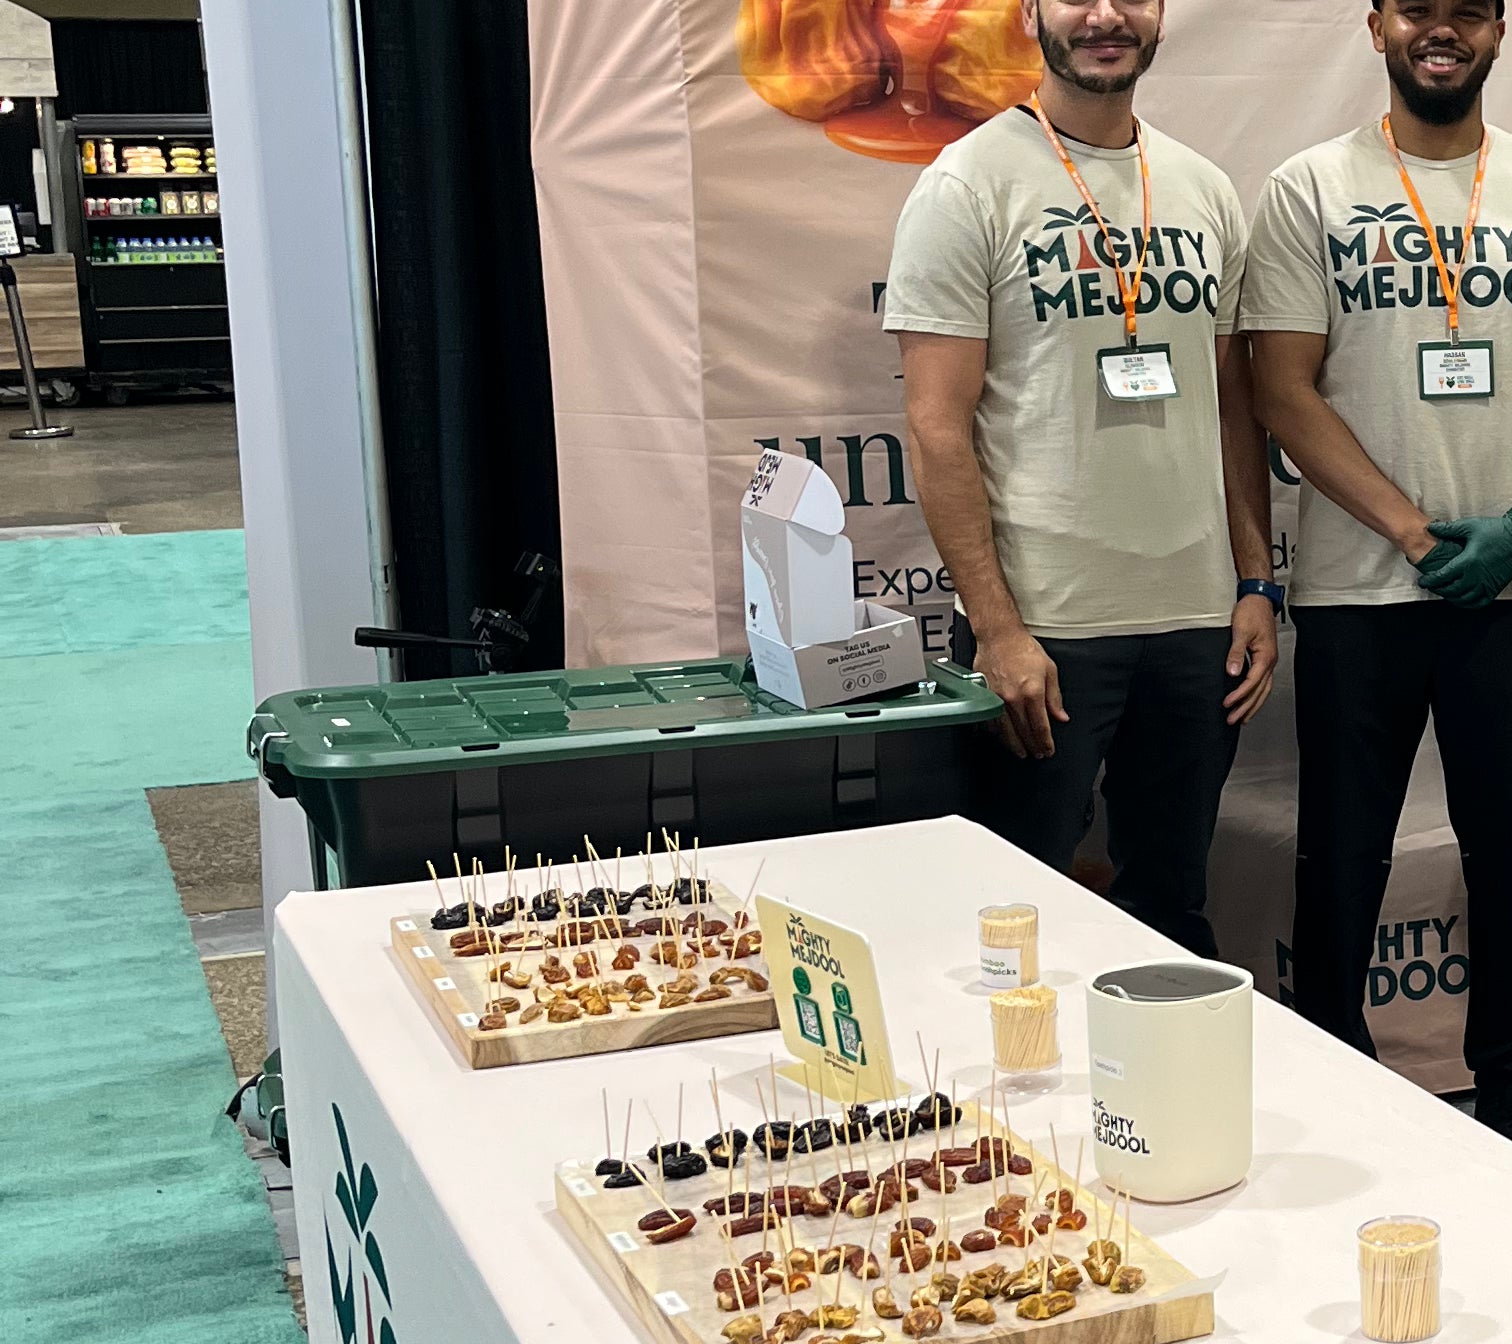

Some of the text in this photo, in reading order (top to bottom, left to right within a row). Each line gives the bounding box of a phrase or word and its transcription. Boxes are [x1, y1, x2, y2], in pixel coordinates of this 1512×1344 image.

[1022, 226, 1207, 278] MIGHTY
[1030, 269, 1220, 322] MEJDOO
[827, 643, 891, 665] ON SOCIAL MEDIA
[786, 922, 831, 956] MIGHTY
[790, 942, 845, 979] MEJDOOL
